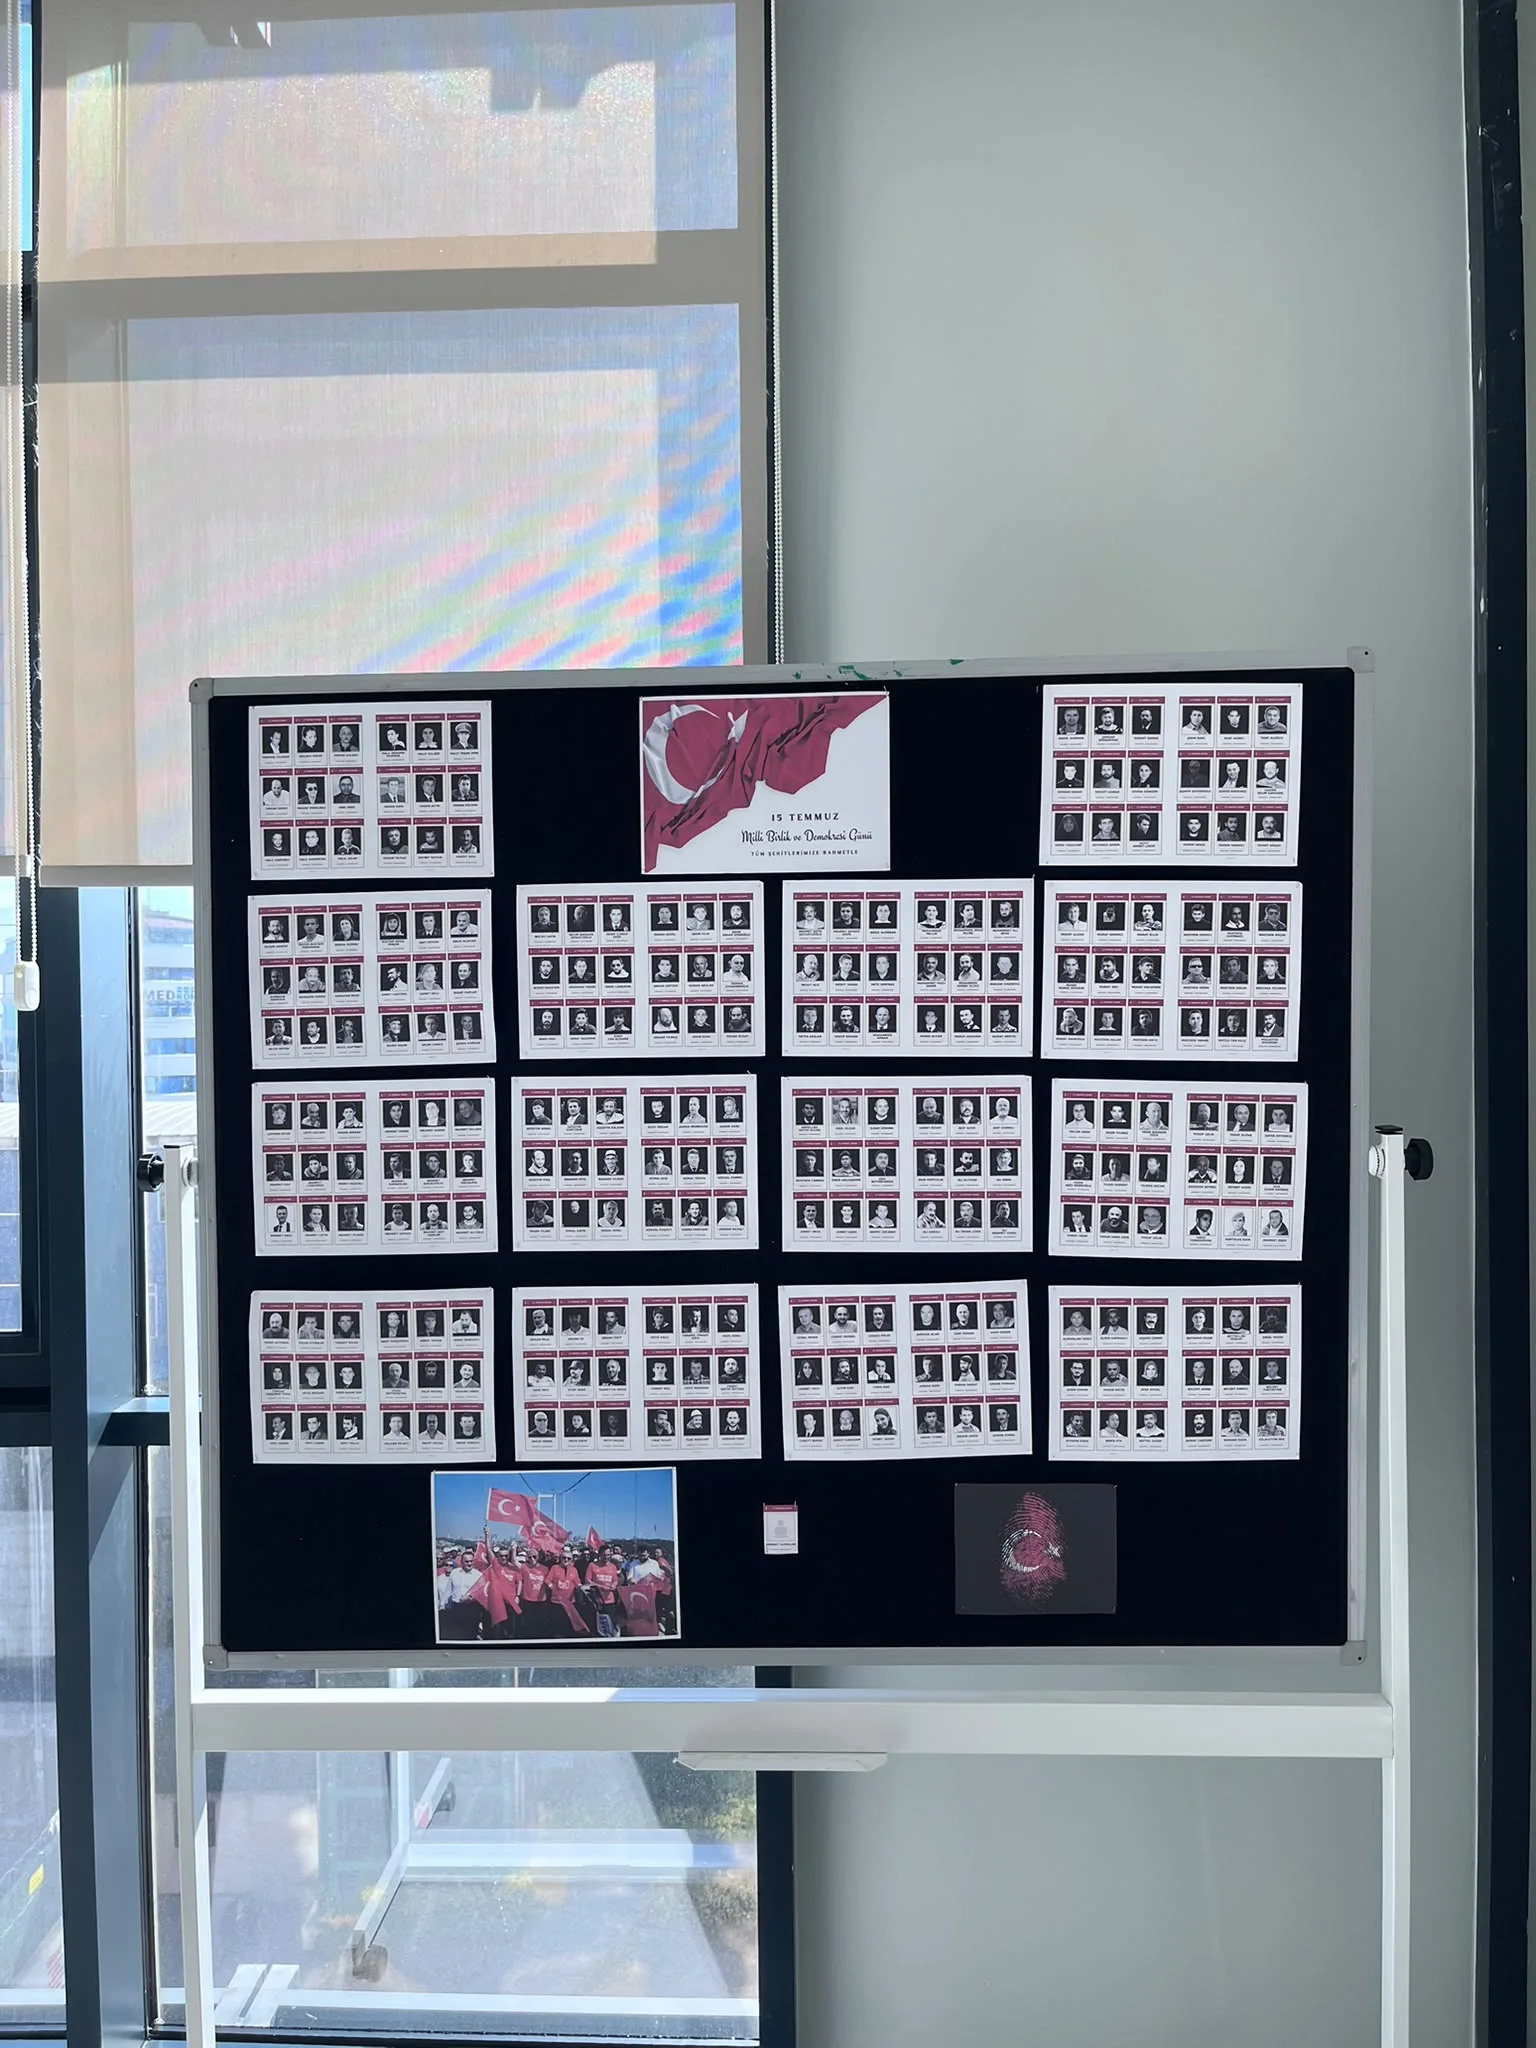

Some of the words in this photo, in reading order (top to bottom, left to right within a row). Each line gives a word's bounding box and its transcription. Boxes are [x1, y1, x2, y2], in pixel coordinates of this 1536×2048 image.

[771, 814, 782, 822] 15
[788, 813, 840, 822] TEMMUZ
[741, 830, 763, 845] Milli
[766, 829, 791, 843] Birlik
[804, 829, 846, 842] Demokrasi
[848, 828, 873, 842] Günü
[751, 849, 765, 857] TÜM
